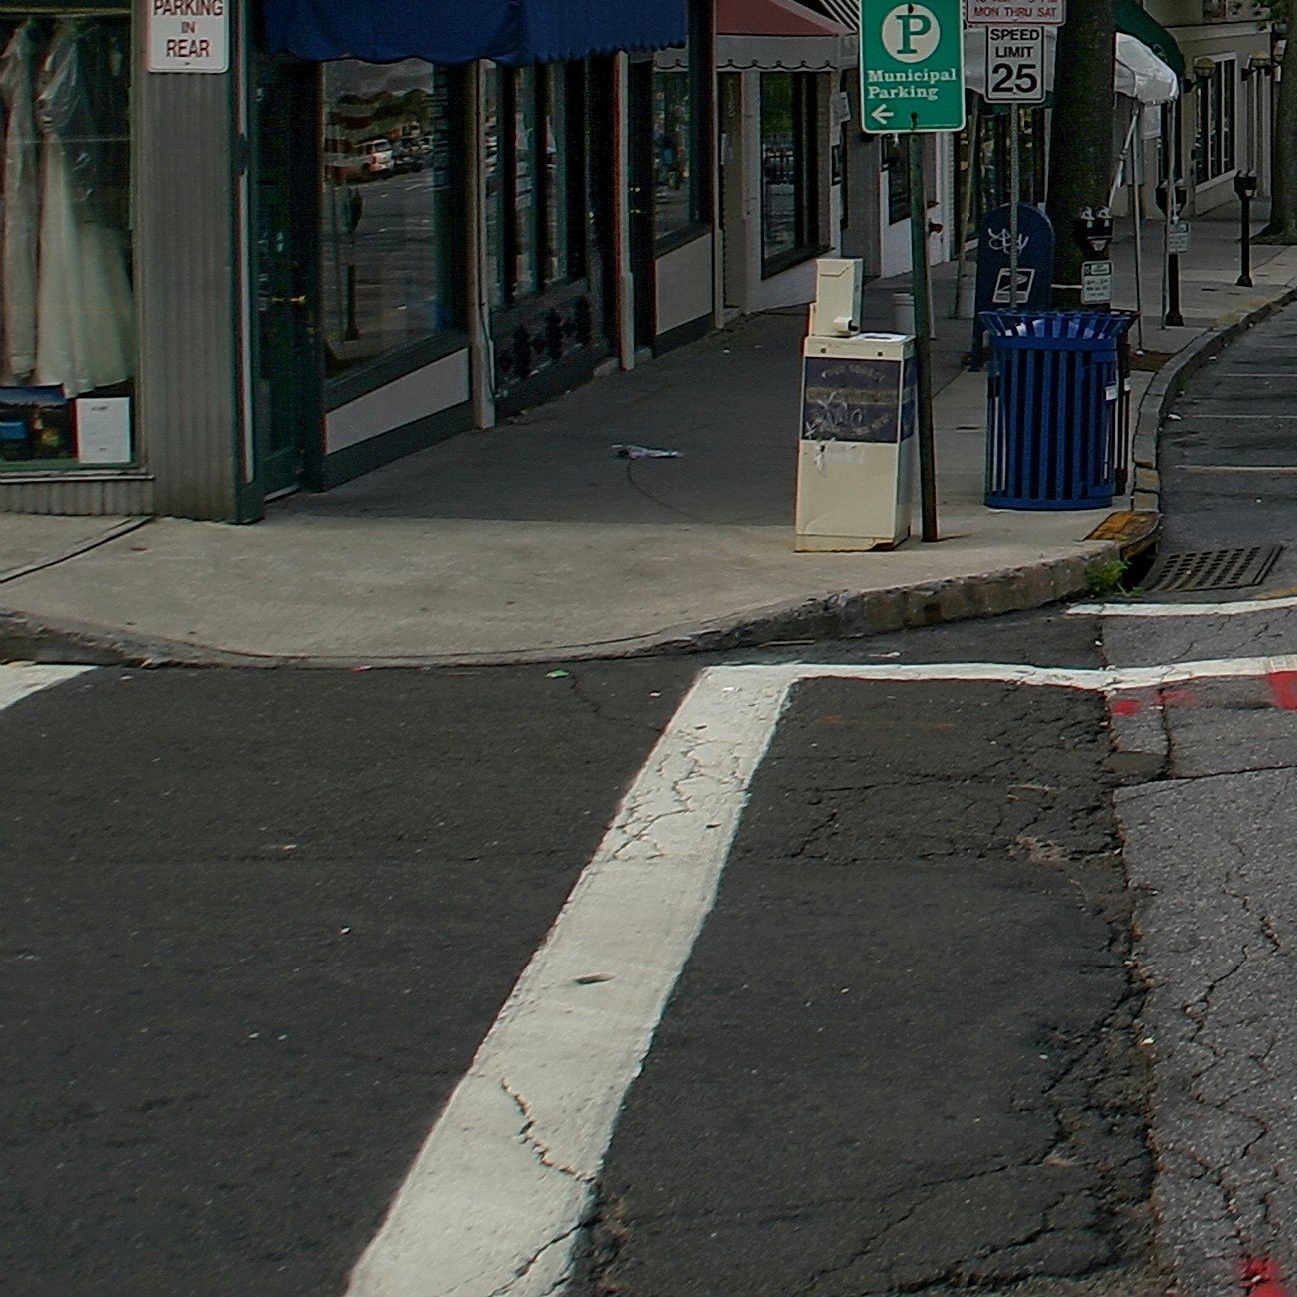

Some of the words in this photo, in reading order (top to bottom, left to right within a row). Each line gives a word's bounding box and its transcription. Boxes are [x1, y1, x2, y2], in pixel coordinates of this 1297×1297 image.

[974, 7, 999, 16] MON
[1004, 7, 1032, 17] THRU
[1038, 7, 1056, 17] SAT
[181, 21, 195, 34] IN
[990, 28, 1040, 41] SPEED
[166, 39, 210, 57] REAR
[995, 46, 1034, 58] LIMIT
[868, 68, 957, 84] Municipal
[991, 63, 1038, 93] 25
[868, 86, 939, 101] Parking
